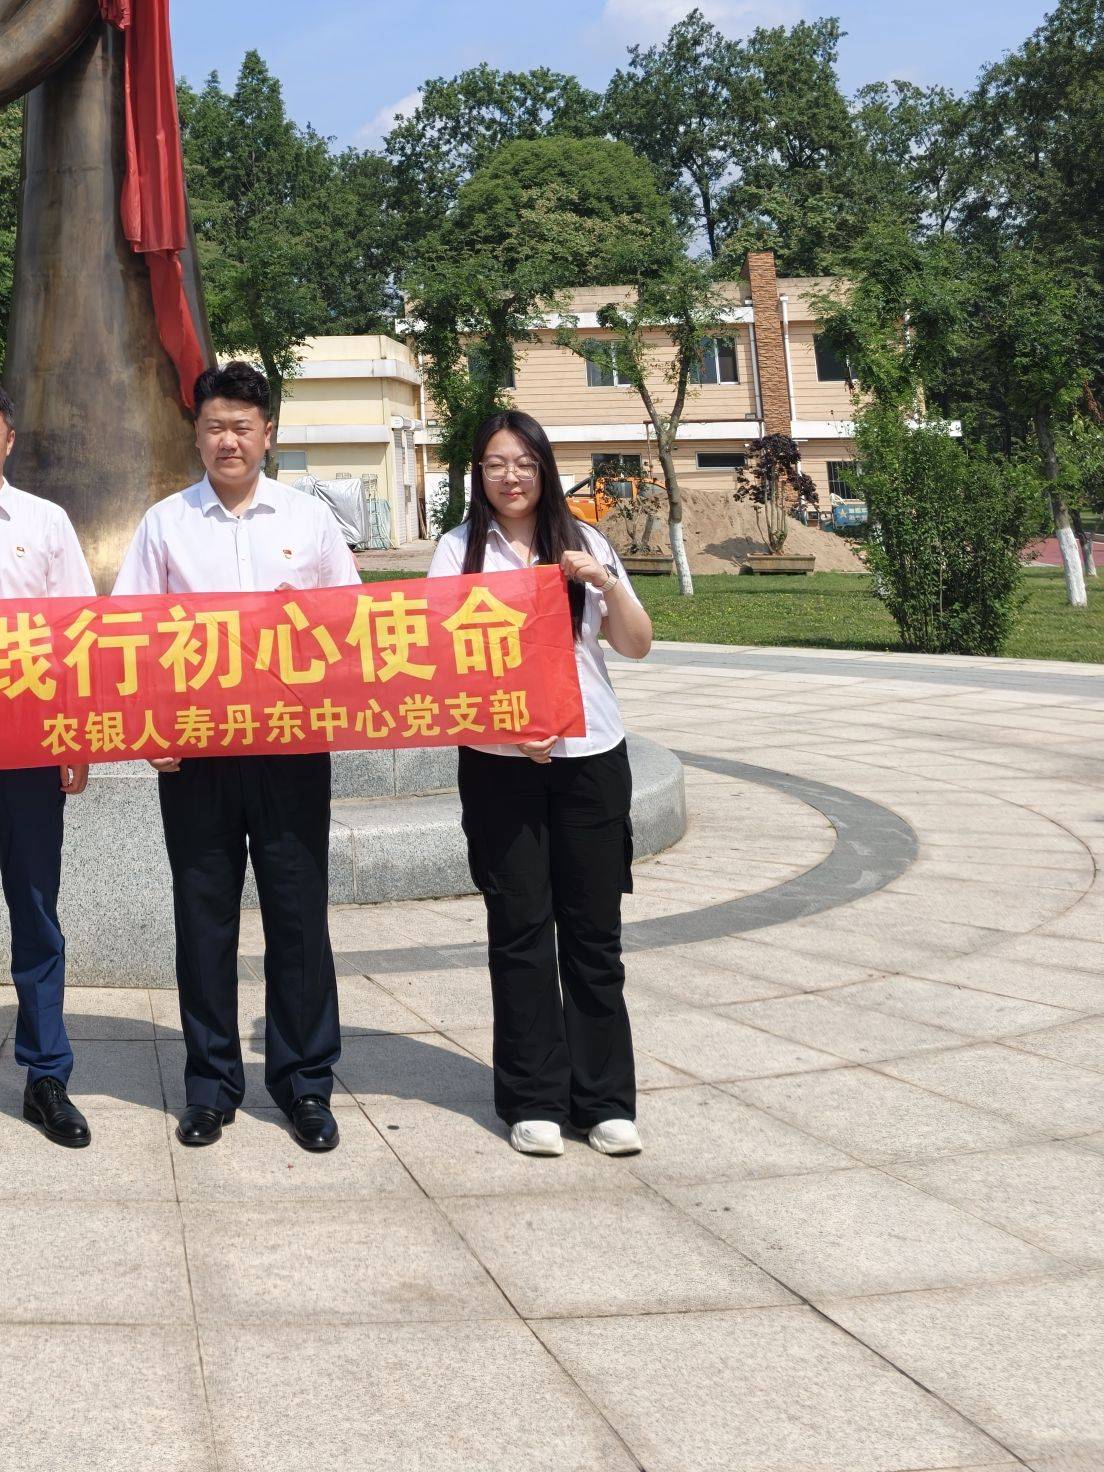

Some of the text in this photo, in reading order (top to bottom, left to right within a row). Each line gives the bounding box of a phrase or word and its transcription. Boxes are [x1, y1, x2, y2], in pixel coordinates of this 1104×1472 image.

[41, 689, 530, 756] 农银人寿丹东中心党支部
